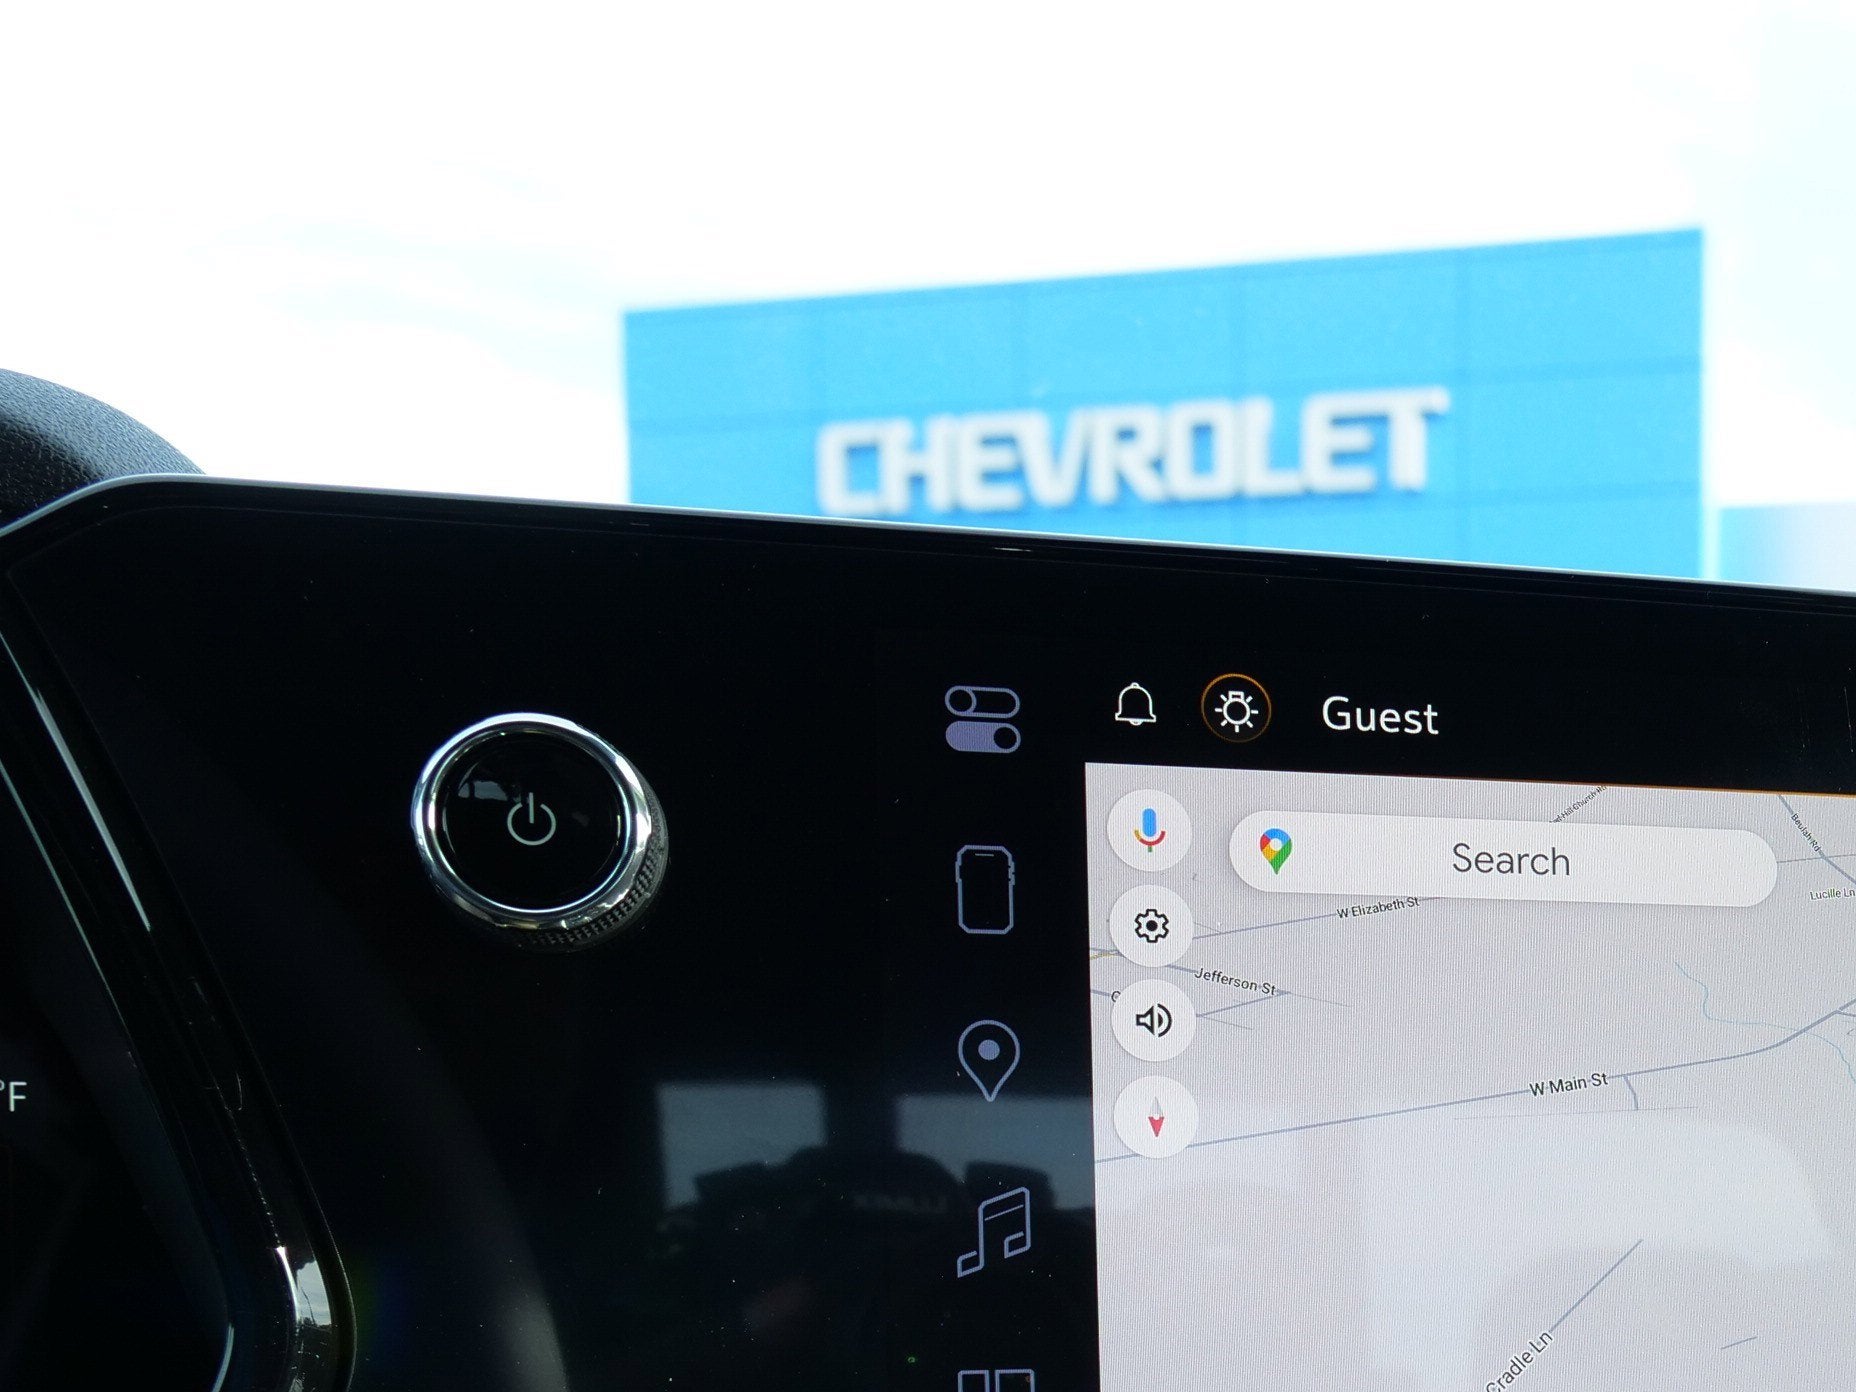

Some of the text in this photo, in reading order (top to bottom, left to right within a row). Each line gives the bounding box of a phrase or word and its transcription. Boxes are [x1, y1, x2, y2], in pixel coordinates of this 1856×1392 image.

[815, 385, 1451, 516] CHEVROLET
[1323, 696, 1439, 735] Guest
[1790, 812, 1813, 842] Beulah
[1452, 843, 1570, 879] Search
[1337, 896, 1420, 919] W Elizabeth St
[1809, 887, 1856, 900] Lucille Ln
[1194, 967, 1276, 996] Jefferson St
[1529, 1072, 1609, 1097] W Main St
[1528, 1332, 1554, 1354] Ln
